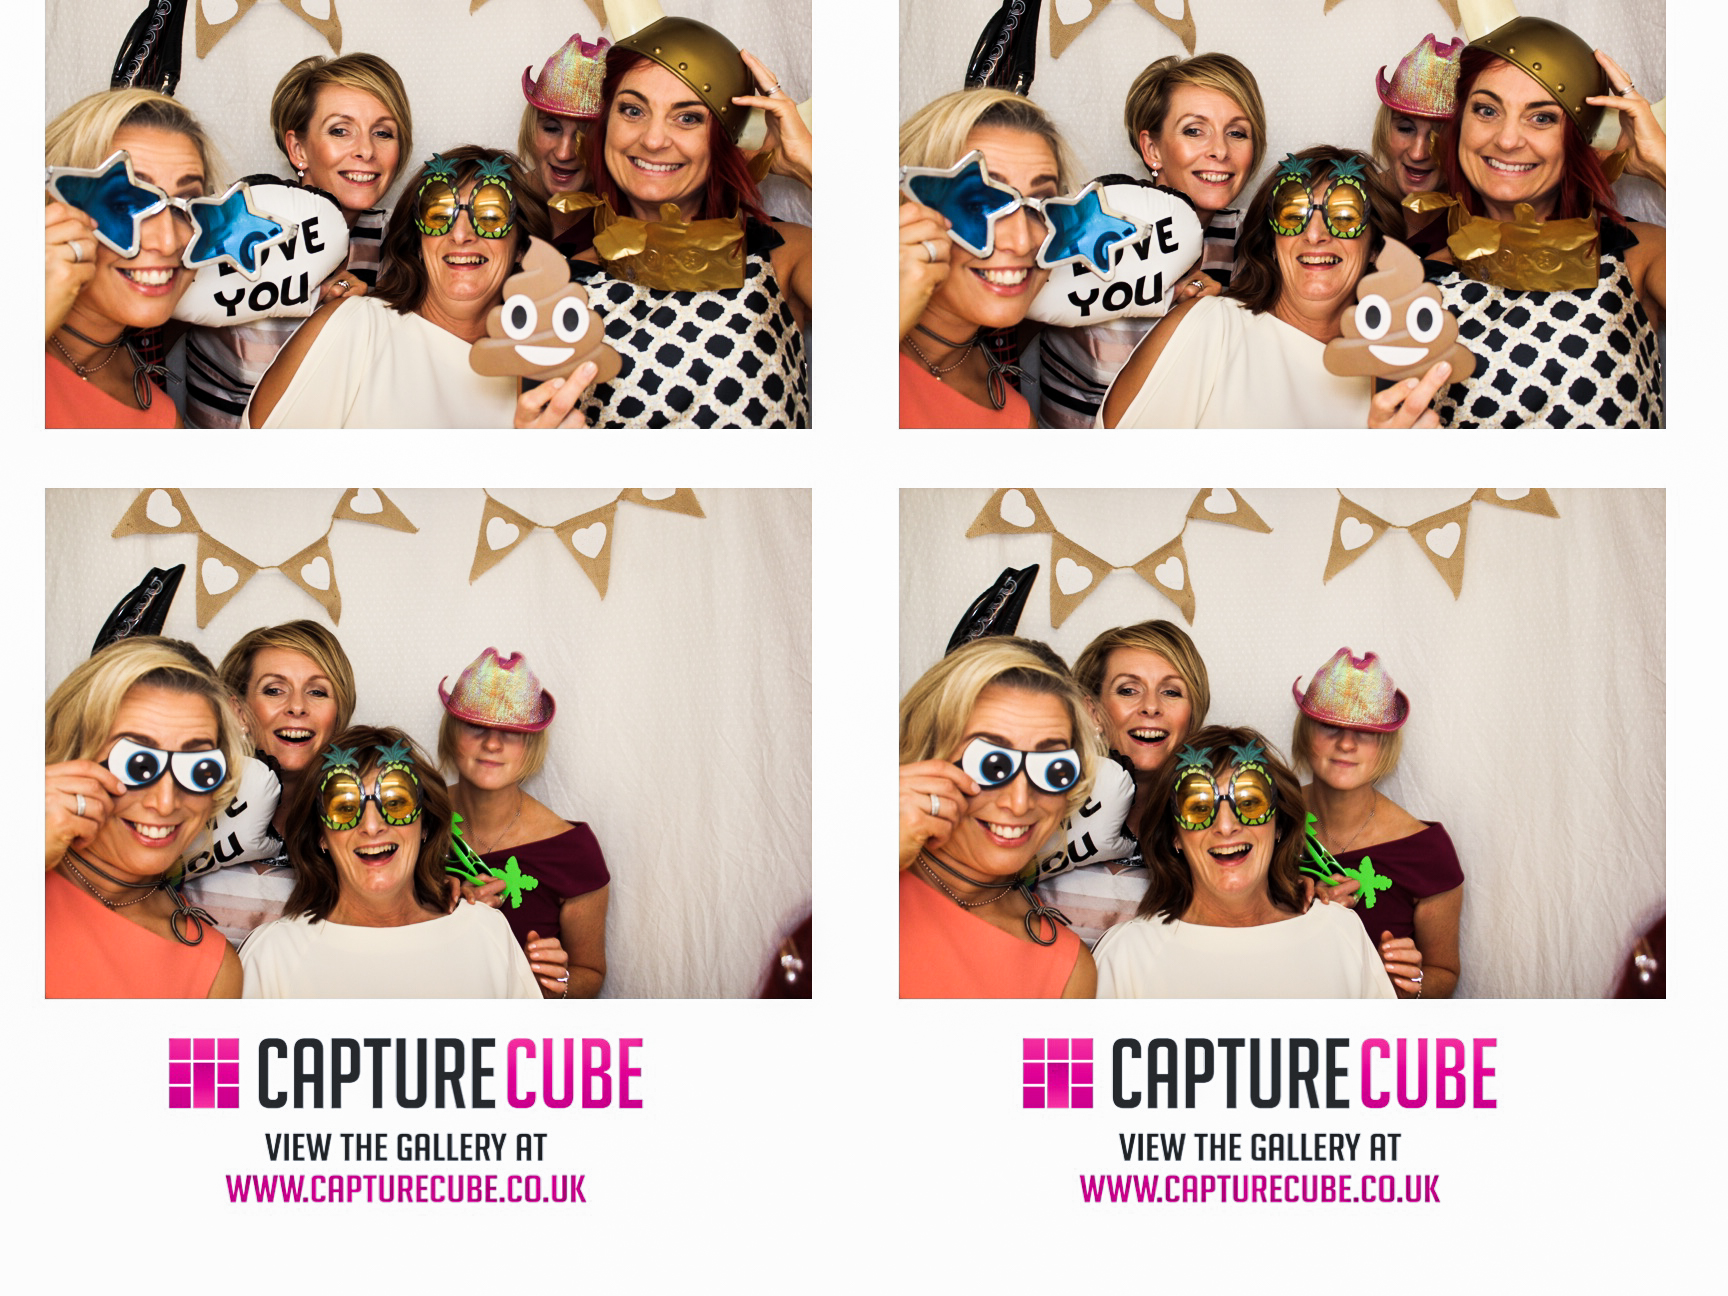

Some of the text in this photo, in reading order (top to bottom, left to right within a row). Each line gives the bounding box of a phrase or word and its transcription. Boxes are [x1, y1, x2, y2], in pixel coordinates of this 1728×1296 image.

[213, 271, 309, 317] YOU
[1067, 271, 1163, 317] YOU
[187, 831, 245, 874] OU
[1041, 831, 1099, 874] OU
